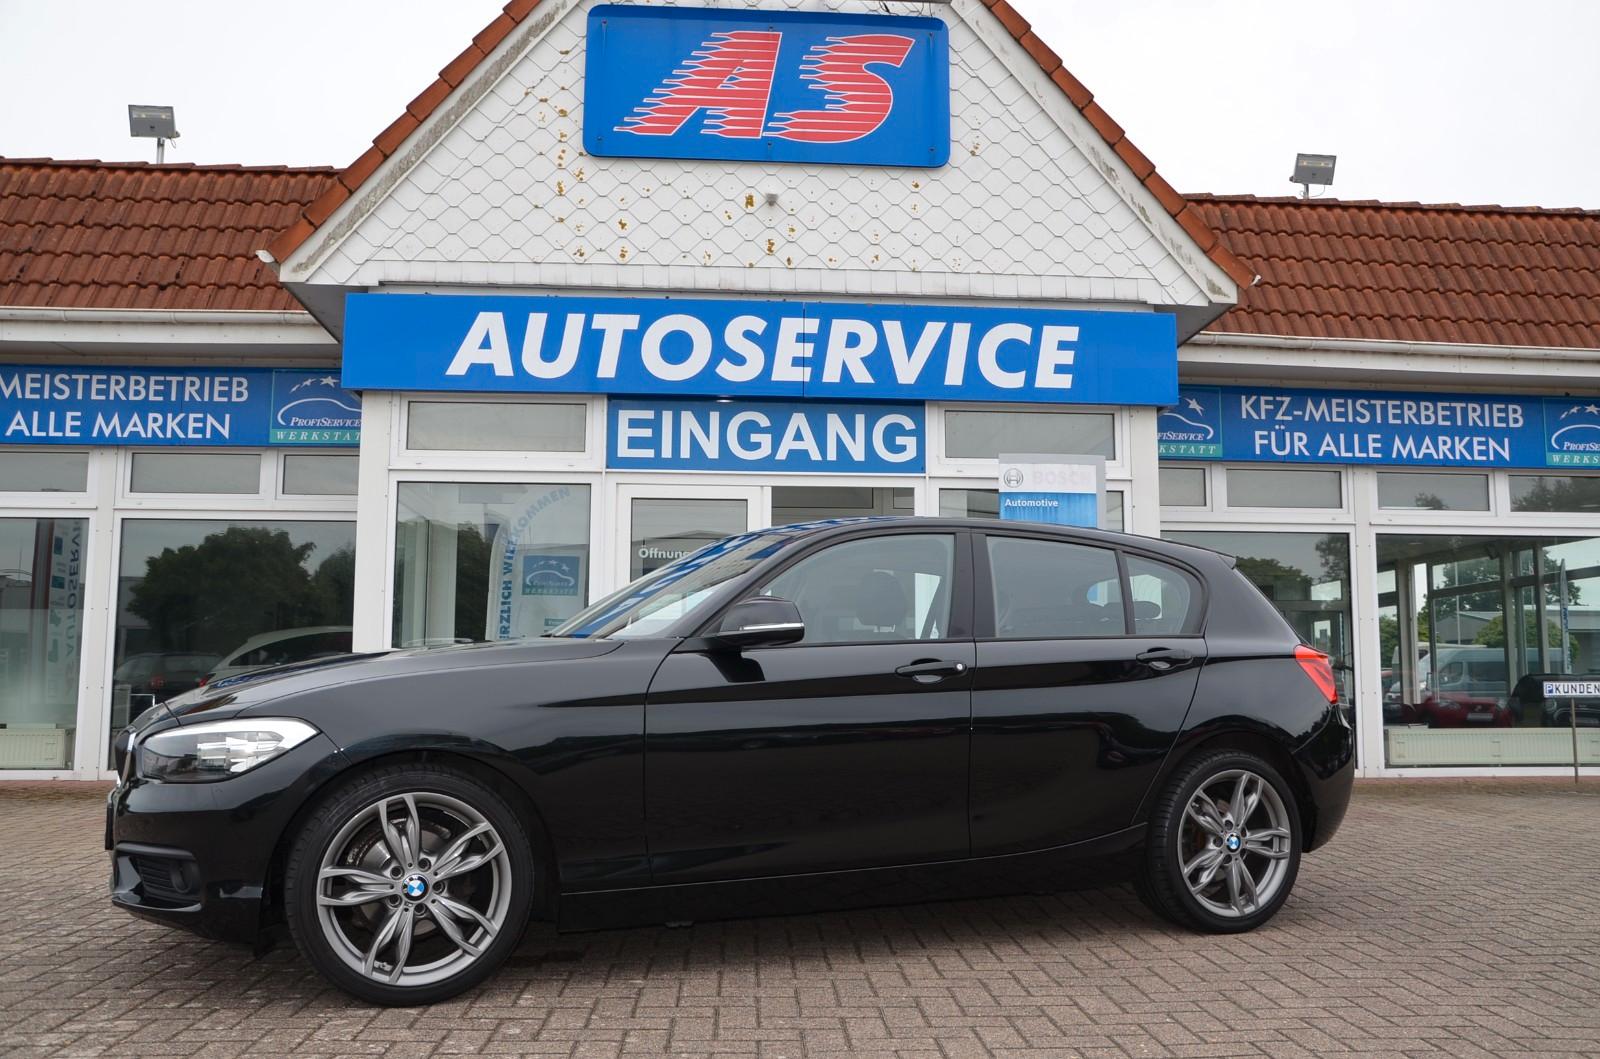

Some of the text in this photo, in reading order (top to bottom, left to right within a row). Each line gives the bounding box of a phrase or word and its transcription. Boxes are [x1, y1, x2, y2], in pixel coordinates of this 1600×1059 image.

[612, 30, 916, 144] AS
[445, 311, 1081, 389] AUTOSERVICE
[0, 373, 249, 402] MEISTERBETRIEB
[5, 410, 231, 440] ALLE MARKEN
[1241, 395, 1524, 428] KFZ-MEISTERBETRIEB
[616, 409, 918, 463] EINGANG
[1254, 424, 1511, 462] FÜR ALLE MARKEN
[1005, 498, 1059, 508] Automotive
[1554, 683, 1600, 695] KUNDEN
